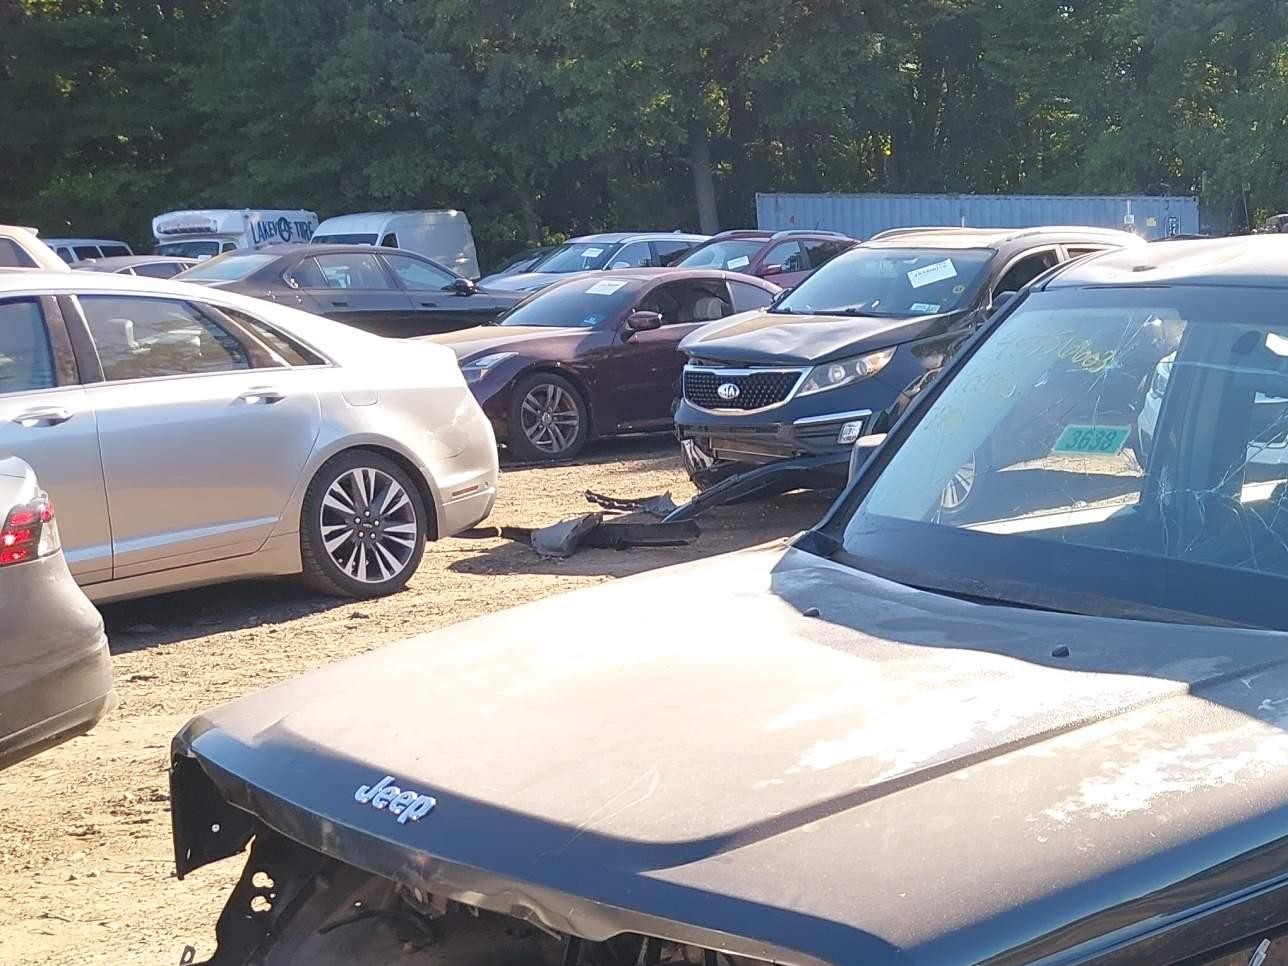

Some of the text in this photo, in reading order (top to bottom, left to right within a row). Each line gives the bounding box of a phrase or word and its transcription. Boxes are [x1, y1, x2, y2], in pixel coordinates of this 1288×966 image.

[718, 384, 740, 399] KIA
[1065, 430, 1117, 450] 3638
[354, 775, 437, 824] Jeep
